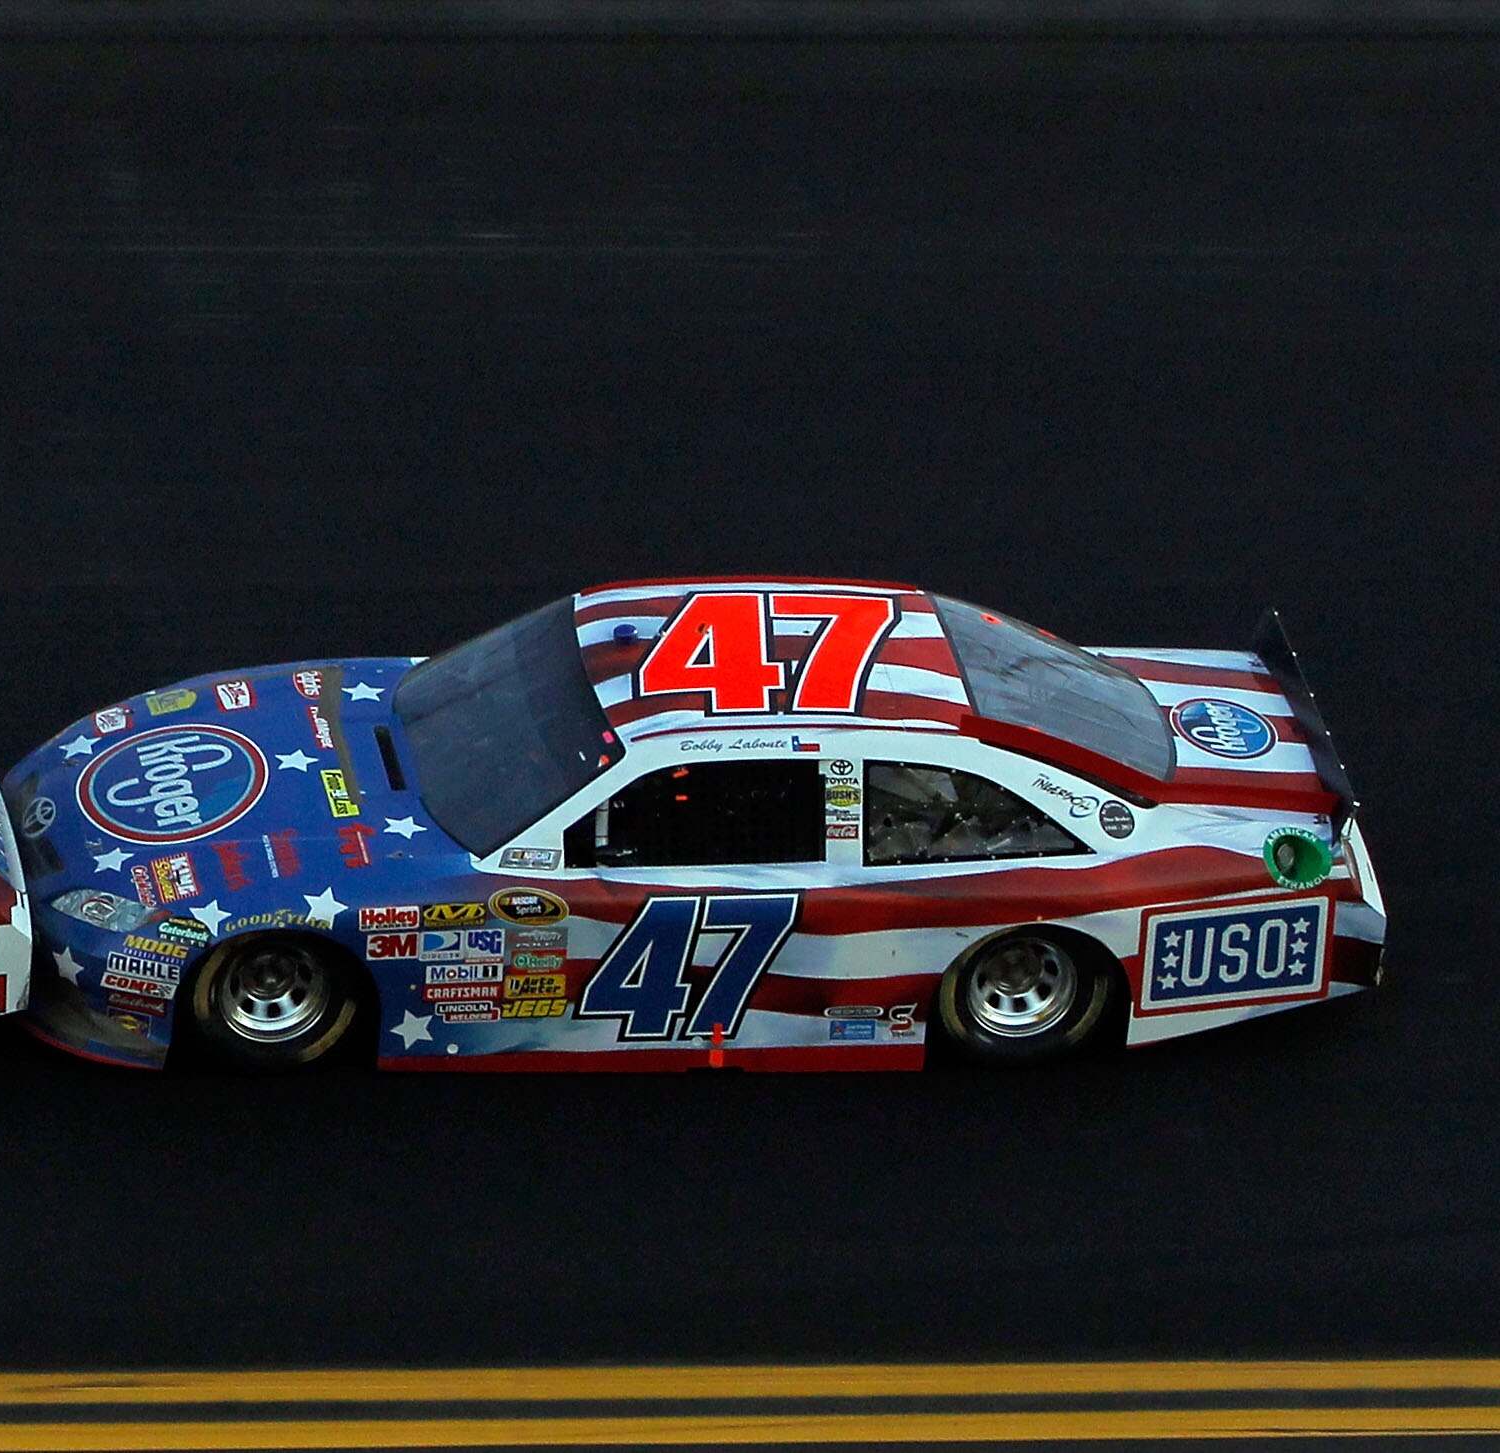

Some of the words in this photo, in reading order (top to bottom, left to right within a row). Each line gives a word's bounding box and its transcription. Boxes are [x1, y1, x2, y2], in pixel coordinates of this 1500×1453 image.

[633, 591, 901, 717] 47
[1191, 702, 1260, 752] Kroger
[680, 739, 723, 753] Bobby
[728, 738, 787, 750] Labonte
[107, 735, 233, 829] Kroger
[825, 777, 859, 785] TOYOTA
[1267, 828, 1317, 846] AMERICAN
[1277, 873, 1326, 890] ETHANOL
[361, 908, 418, 927] Holley
[516, 904, 542, 915] Sprint
[158, 922, 209, 942] Gatorback
[123, 934, 189, 959] MOOG
[368, 934, 417, 958] 3M
[467, 931, 502, 954] USG
[1180, 918, 1287, 987] USO
[109, 952, 179, 981] MAHLE
[431, 965, 478, 980] Mobil
[573, 890, 804, 1041] 47
[105, 975, 158, 992] COMP
[520, 985, 561, 995] Meter
[525, 977, 555, 987] Auto
[427, 987, 498, 999] CRAFTSMAN
[440, 1003, 488, 1013] LINCOLN
[450, 1012, 493, 1021] WELDERS
[502, 999, 568, 1019] JEGS
